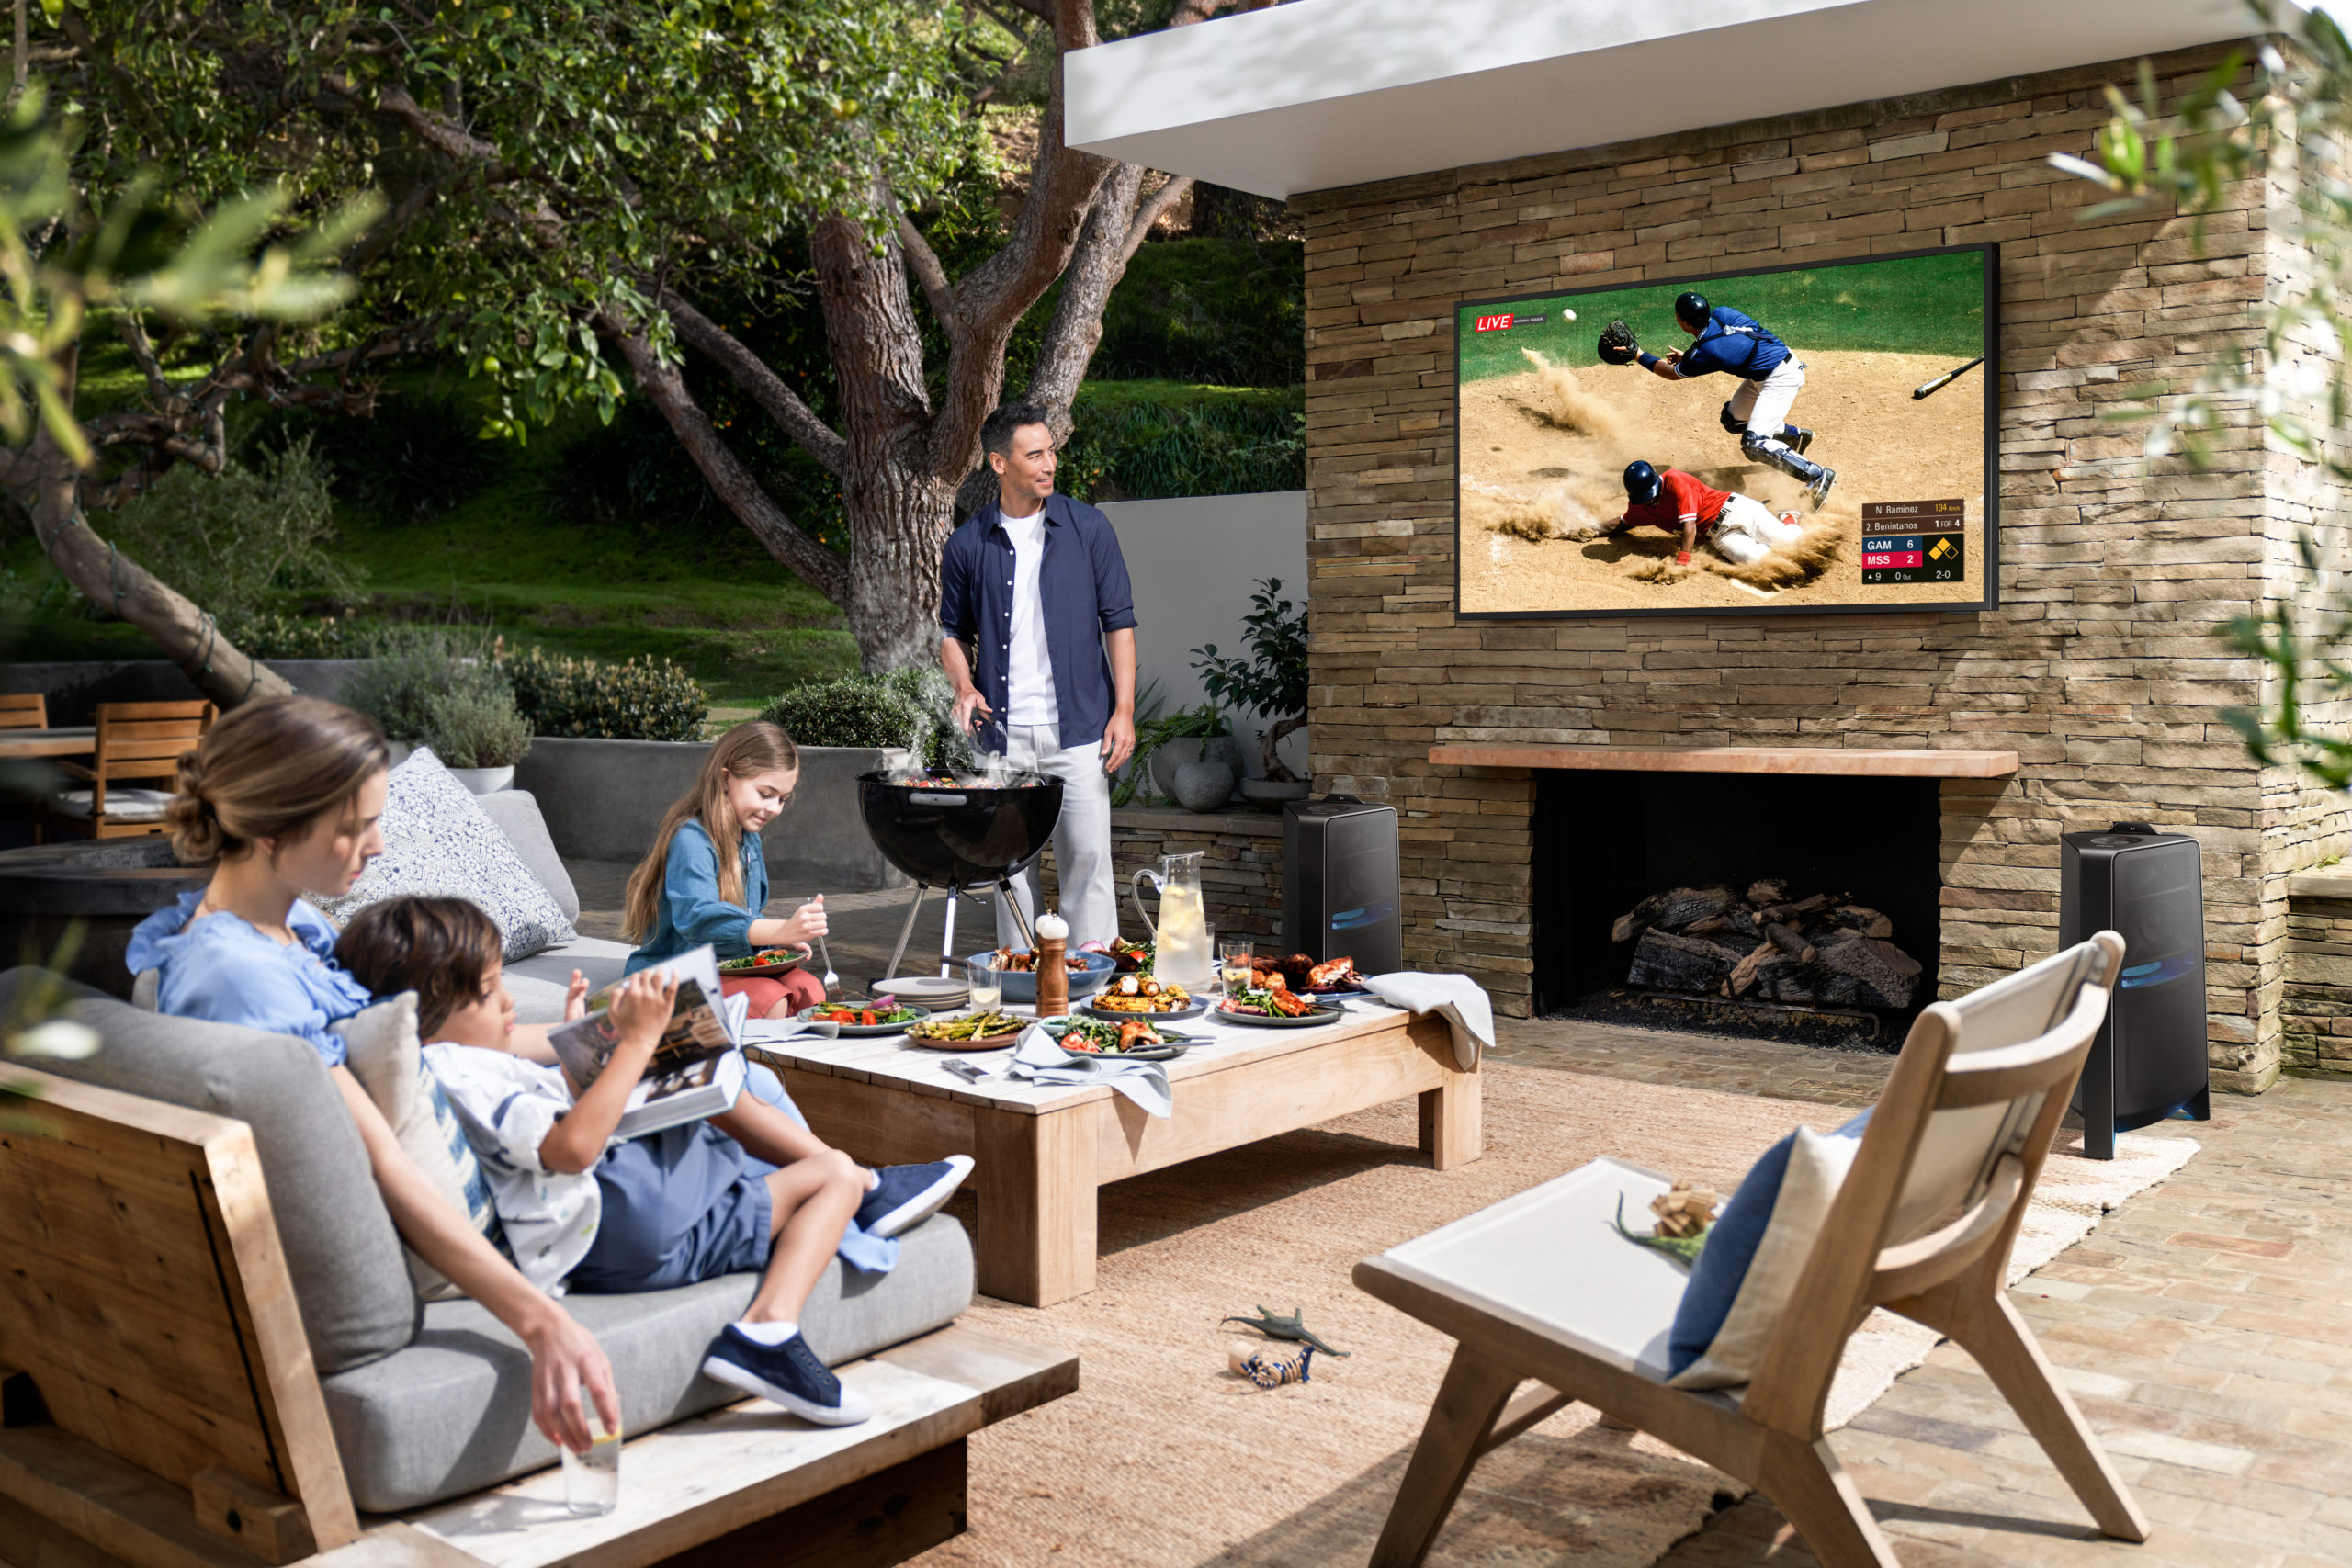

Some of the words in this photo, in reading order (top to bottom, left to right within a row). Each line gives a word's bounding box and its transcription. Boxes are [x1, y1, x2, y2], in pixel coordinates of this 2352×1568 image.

[1477, 315, 1510, 331] LIVE
[1875, 505, 1884, 514] N.
[1886, 505, 1918, 514] Raminez
[1935, 503, 1947, 512] 134
[1866, 523, 1872, 532] 2.
[1874, 522, 1918, 531] Benintanos
[1954, 519, 1960, 527] 4
[1867, 540, 1892, 550] GAM
[1907, 539, 1914, 548] 6
[1867, 555, 1890, 565] MSS
[1907, 555, 1914, 564] 2
[1875, 572, 1882, 581] 9
[1894, 571, 1901, 581] 0
[1936, 570, 1951, 580] 2-0
